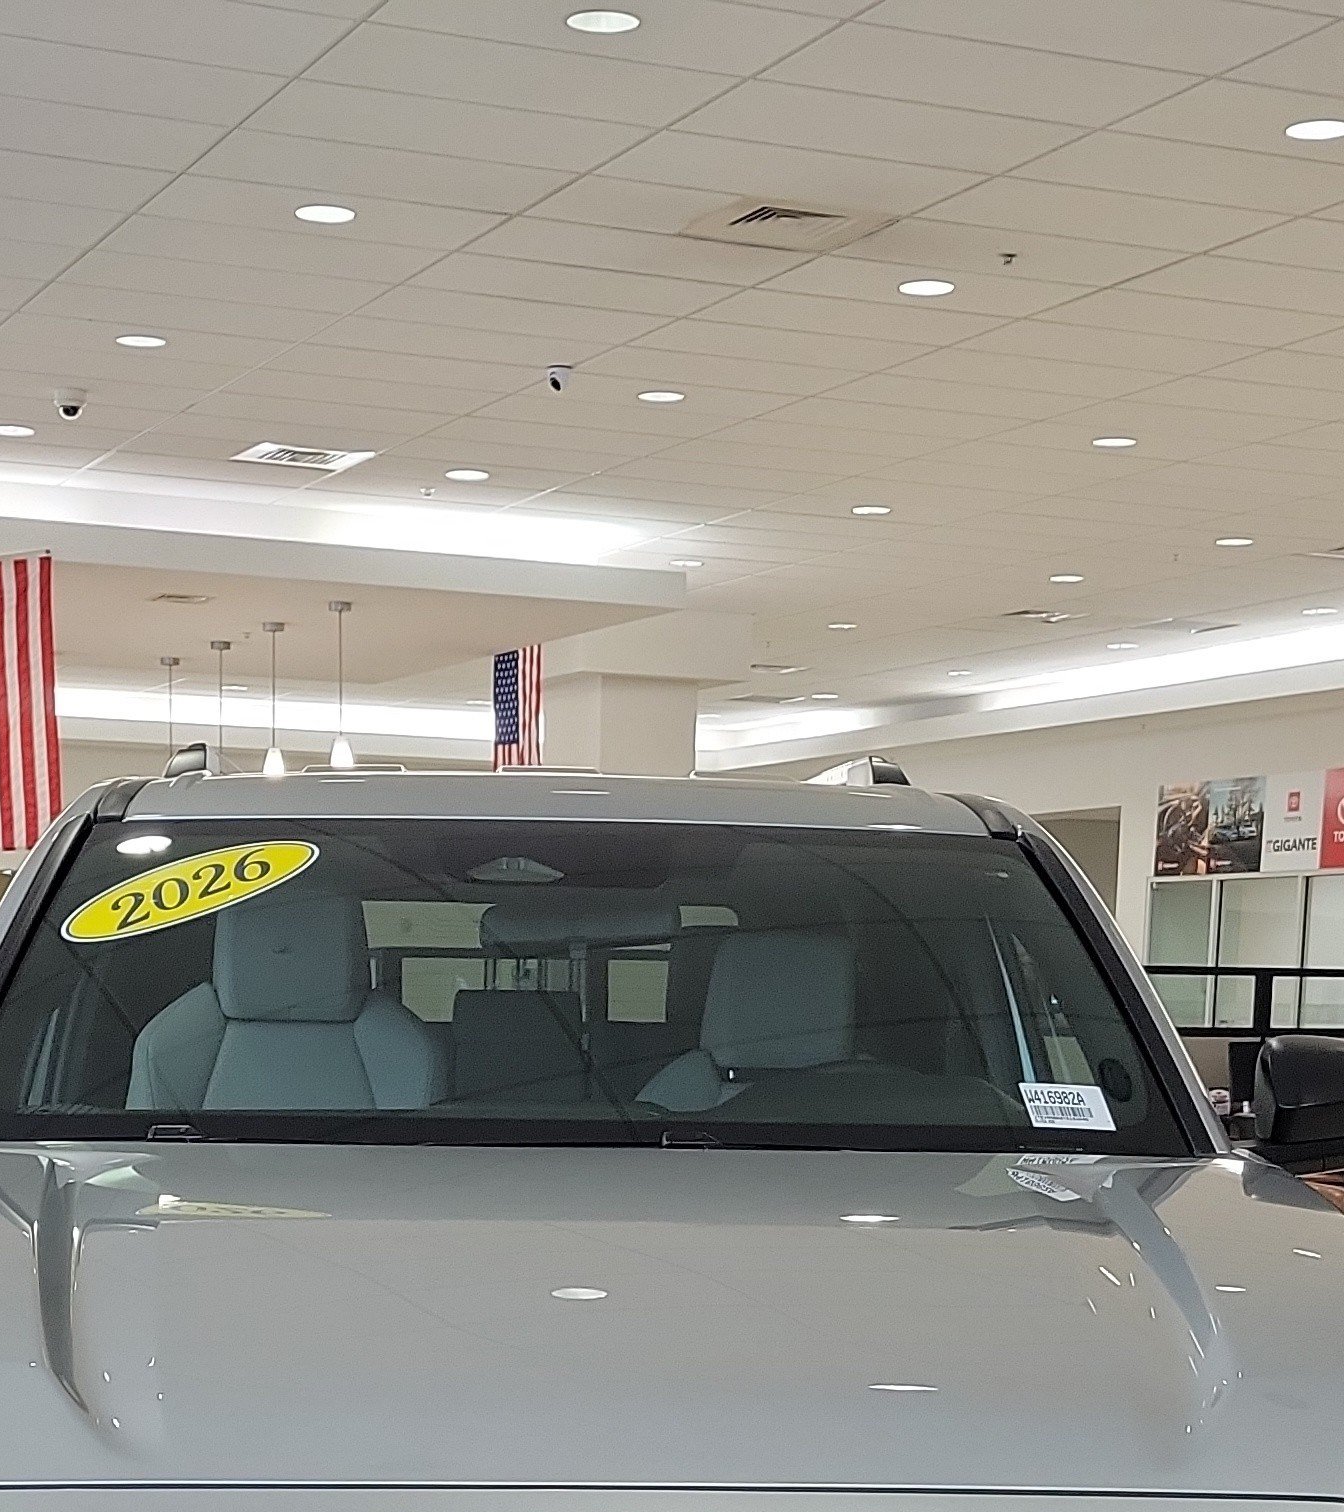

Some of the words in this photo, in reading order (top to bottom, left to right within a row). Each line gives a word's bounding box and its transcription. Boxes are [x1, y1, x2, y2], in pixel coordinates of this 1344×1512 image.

[1272, 837, 1317, 852] GIGANTE
[111, 848, 271, 931] 2026
[1024, 1089, 1086, 1106] W416982A
